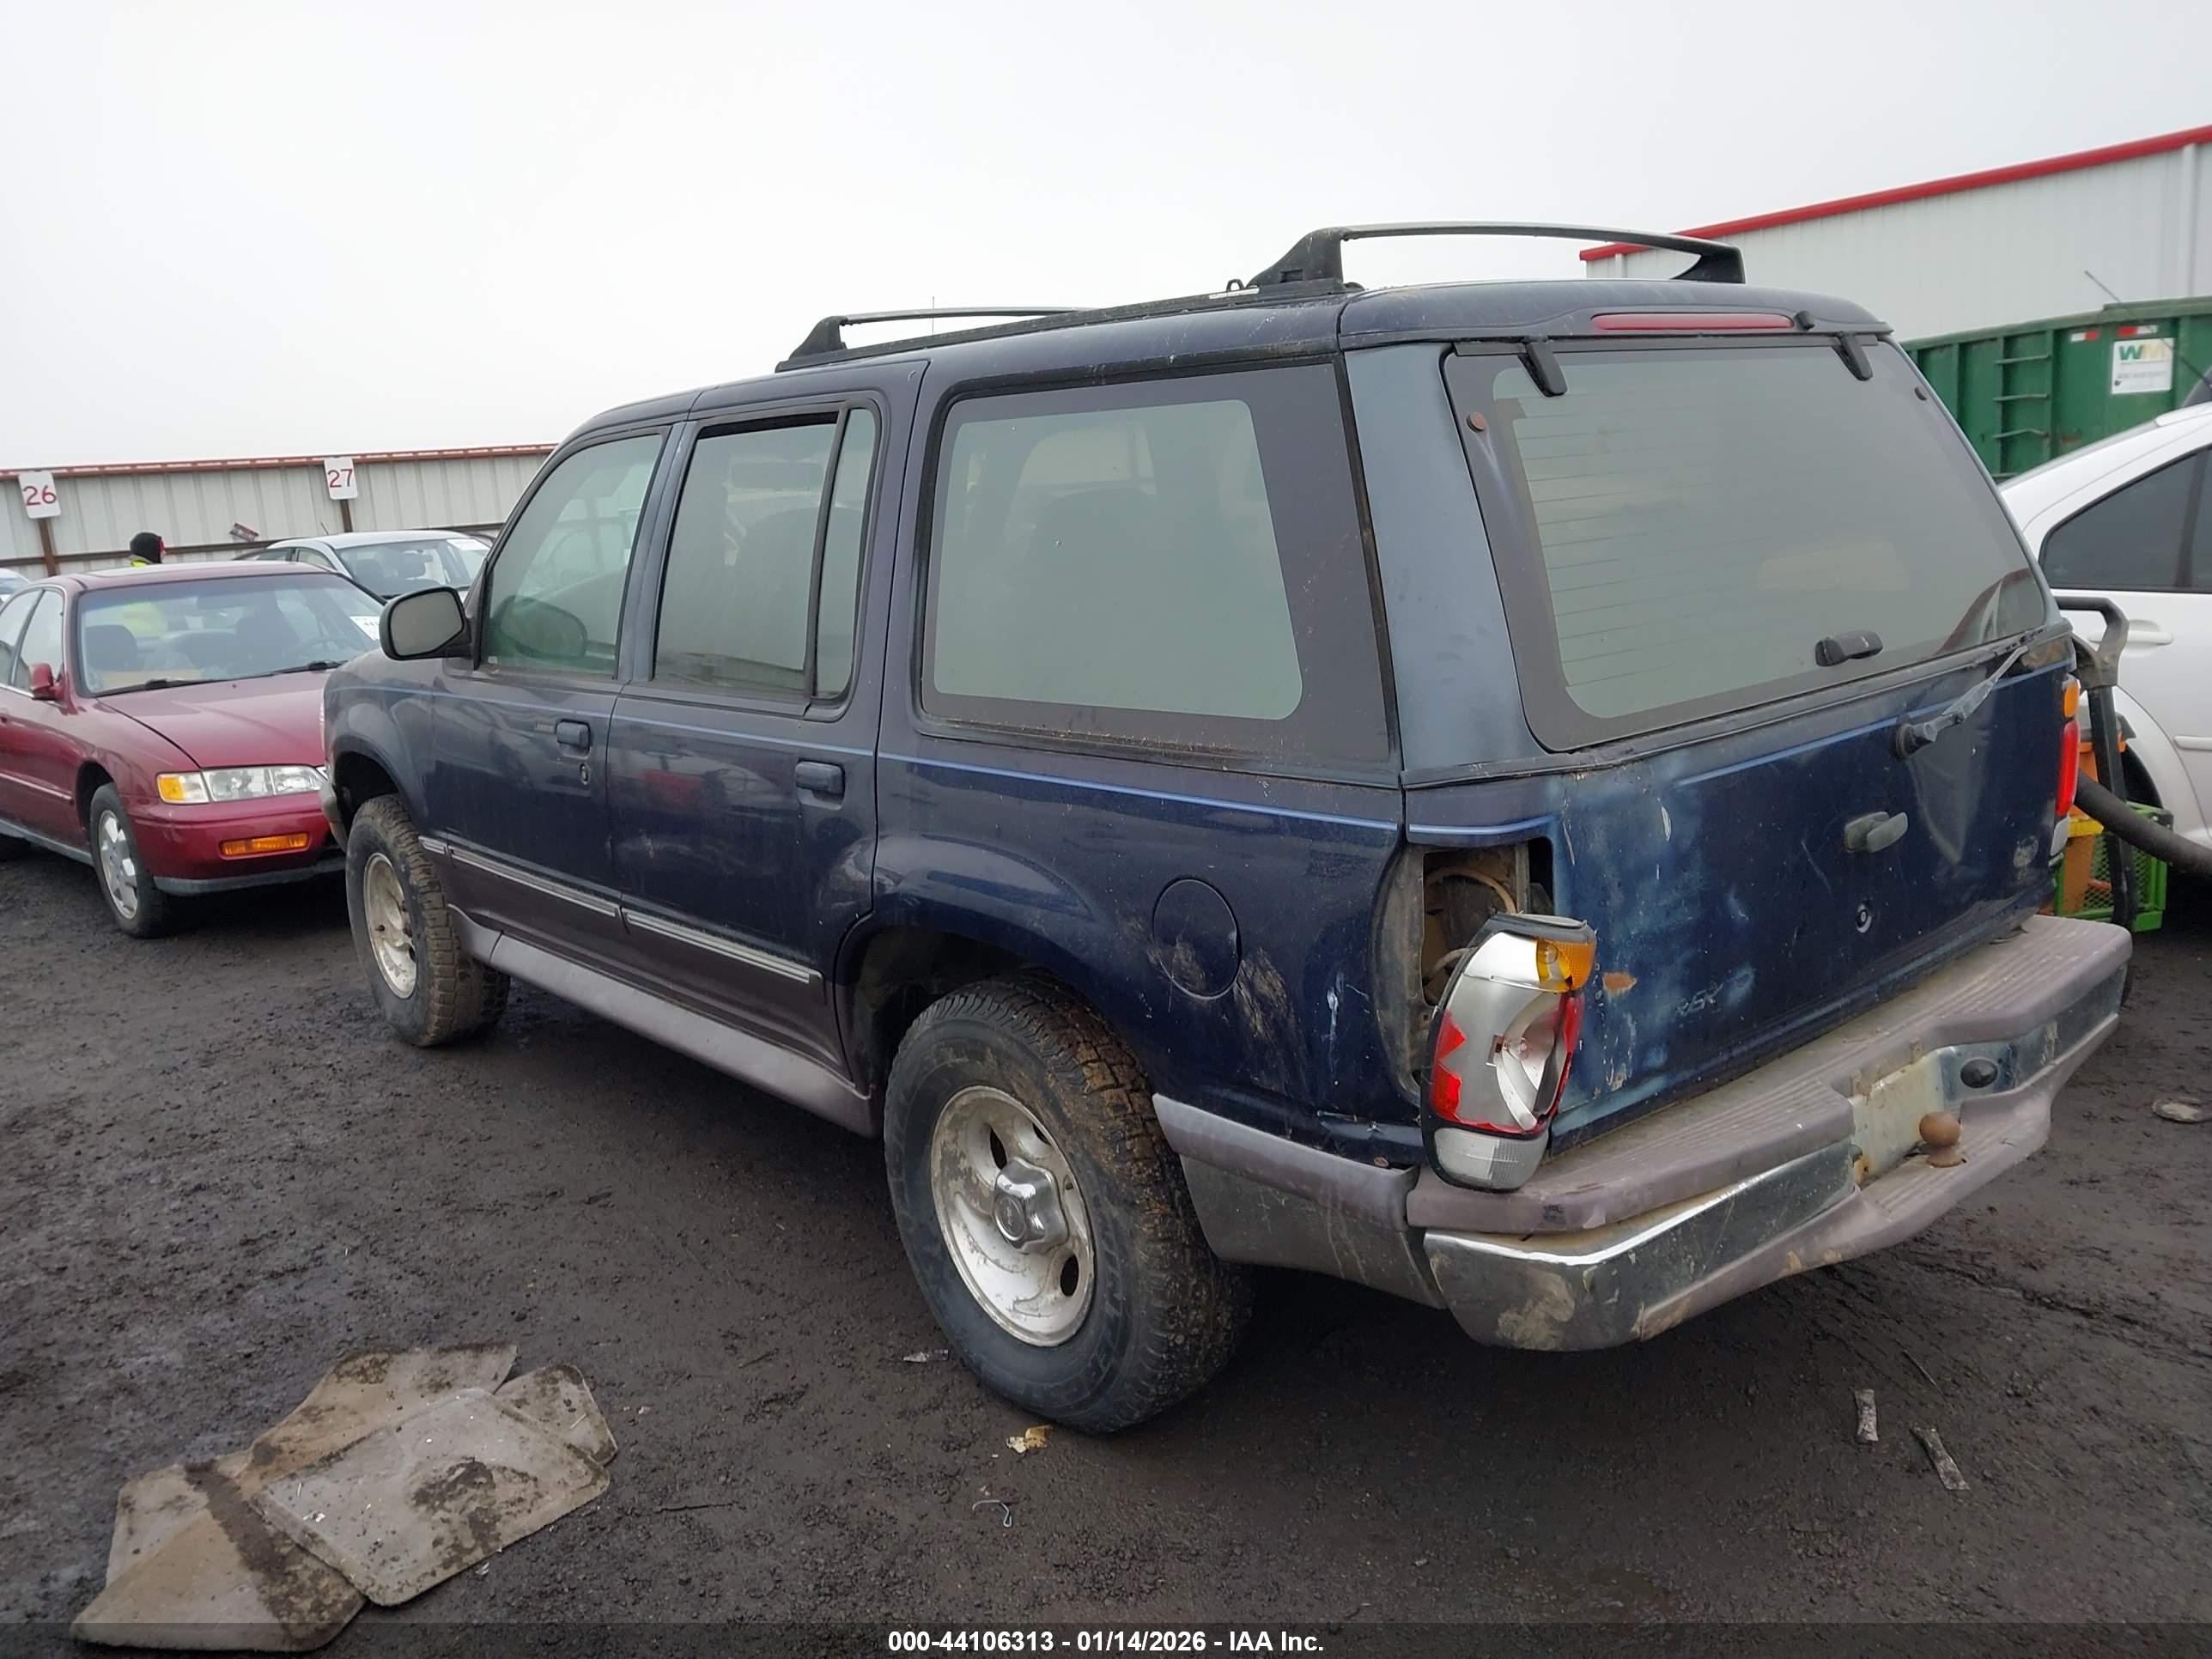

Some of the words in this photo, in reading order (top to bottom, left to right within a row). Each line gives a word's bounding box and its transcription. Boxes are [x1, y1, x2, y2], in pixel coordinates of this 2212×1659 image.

[2118, 343, 2165, 361] WM
[328, 468, 353, 488] 27
[23, 484, 57, 506] 26
